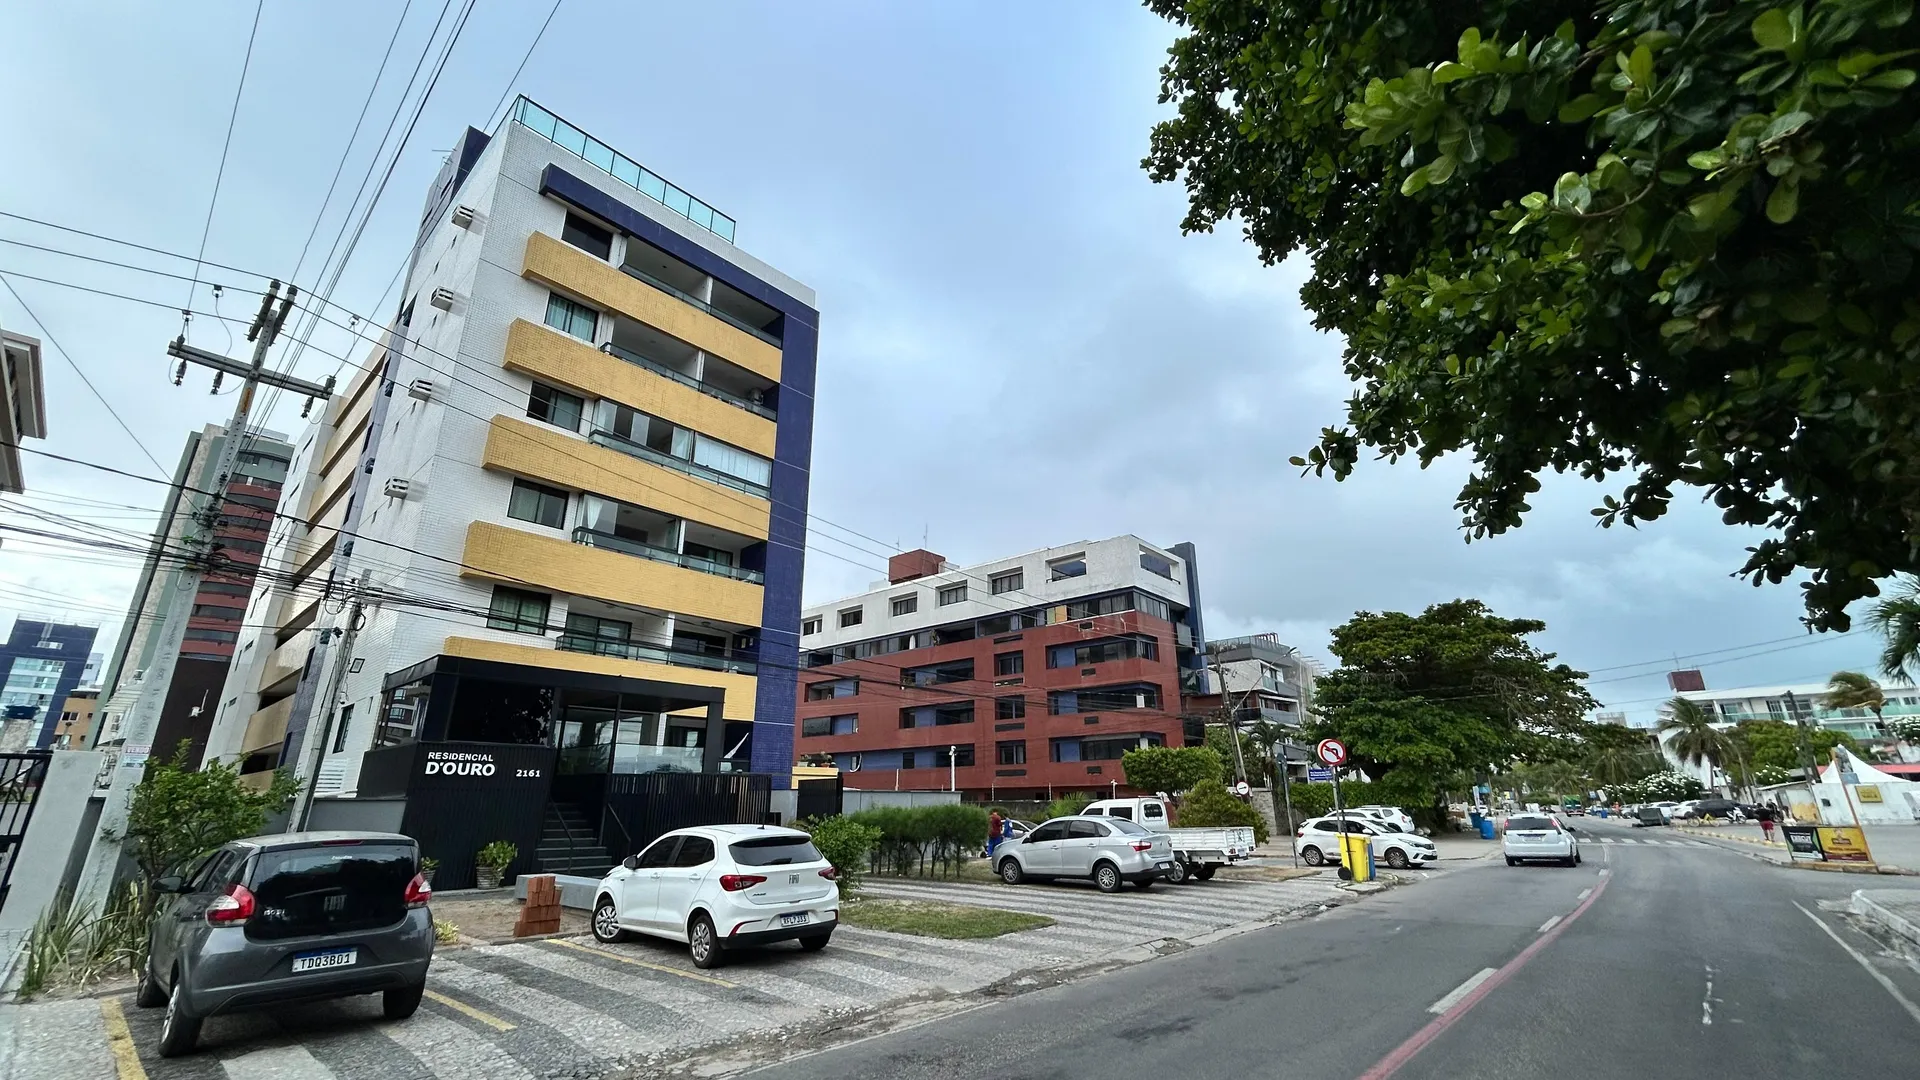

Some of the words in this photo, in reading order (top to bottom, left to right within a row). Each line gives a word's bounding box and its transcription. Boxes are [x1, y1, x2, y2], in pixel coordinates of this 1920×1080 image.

[428, 752, 493, 761] RESIDENCIAL
[425, 762, 495, 776] D'OURO
[516, 769, 540, 777] 2161
[324, 895, 347, 912] FIAT
